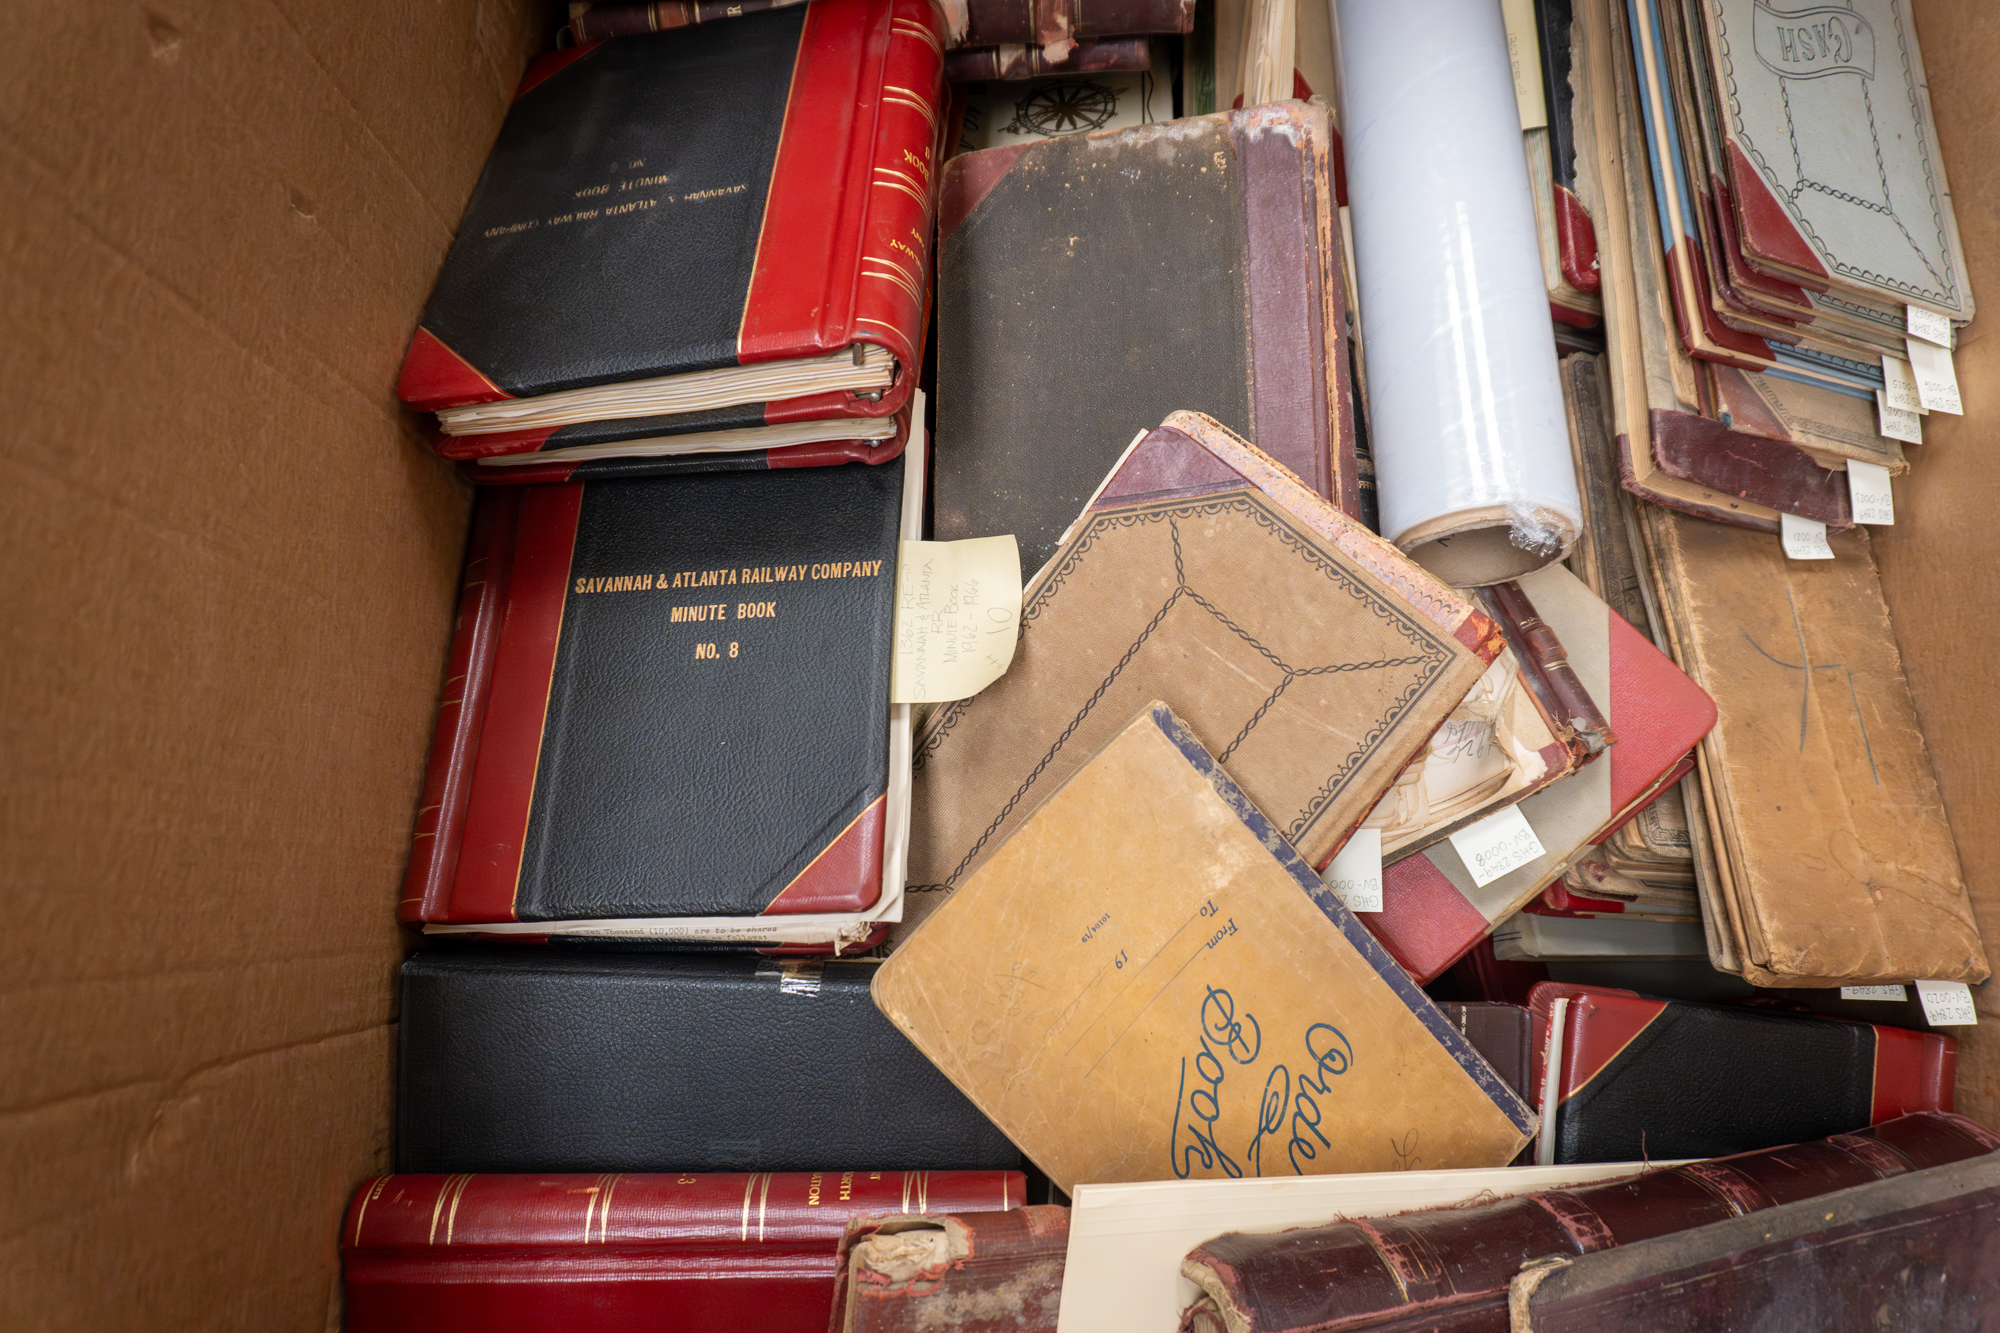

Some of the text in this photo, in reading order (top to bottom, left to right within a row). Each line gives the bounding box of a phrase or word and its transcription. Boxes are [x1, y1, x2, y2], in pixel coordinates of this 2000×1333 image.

[1777, 16, 1852, 63] CASH
[903, 148, 930, 183] BOOK
[575, 174, 669, 200] MINUTE BOOK
[684, 183, 747, 200] SAVANNAH
[547, 208, 599, 226] RAILWAY
[605, 199, 657, 216] ATLANTA
[484, 218, 540, 238] COMPANY
[1914, 307, 1949, 330] BV-0027
[1910, 321, 1950, 344] GHS 2849-
[1883, 420, 1920, 438] GHS 2849-
[1855, 492, 1893, 507] BV-0023
[1856, 507, 1893, 521] GHS 2849-
[1793, 531, 1825, 543] BV-0021
[1789, 543, 1832, 555] GHS 2849-
[575, 560, 882, 594] SAVANNAH & ATLANTA RAILWAY COMPANY
[916, 558, 934, 610] ATLANTA
[963, 578, 980, 606] 1966
[671, 601, 777, 623] MINUTE BOOK
[899, 563, 915, 655] 1362 RE-10
[931, 609, 944, 635] RR
[985, 606, 1013, 635] 10
[961, 623, 978, 653] 1962
[696, 641, 739, 660] NO. 8
[913, 626, 929, 700] SAVANNAH
[1474, 828, 1532, 868] BV-0008
[1477, 841, 1541, 879] GHS 2849-
[1329, 877, 1380, 891] BV-000
[1199, 899, 1219, 918] To
[1354, 894, 1380, 908] GHS
[604, 928, 644, 936] Thousand
[648, 926, 690, 936] (10,000)
[694, 927, 711, 935] are
[730, 926, 741, 934] be
[746, 925, 778, 933] shares
[1080, 912, 1112, 944] 10104/19
[1206, 917, 1239, 950] From
[1114, 949, 1129, 970] 19
[1845, 984, 1903, 997] GHS 2849-
[1925, 990, 1972, 1004] BV-0020
[1929, 1005, 1975, 1022] GHS 2849-
[1171, 983, 1262, 1180] Book
[1288, 1022, 1354, 1177] Orde
